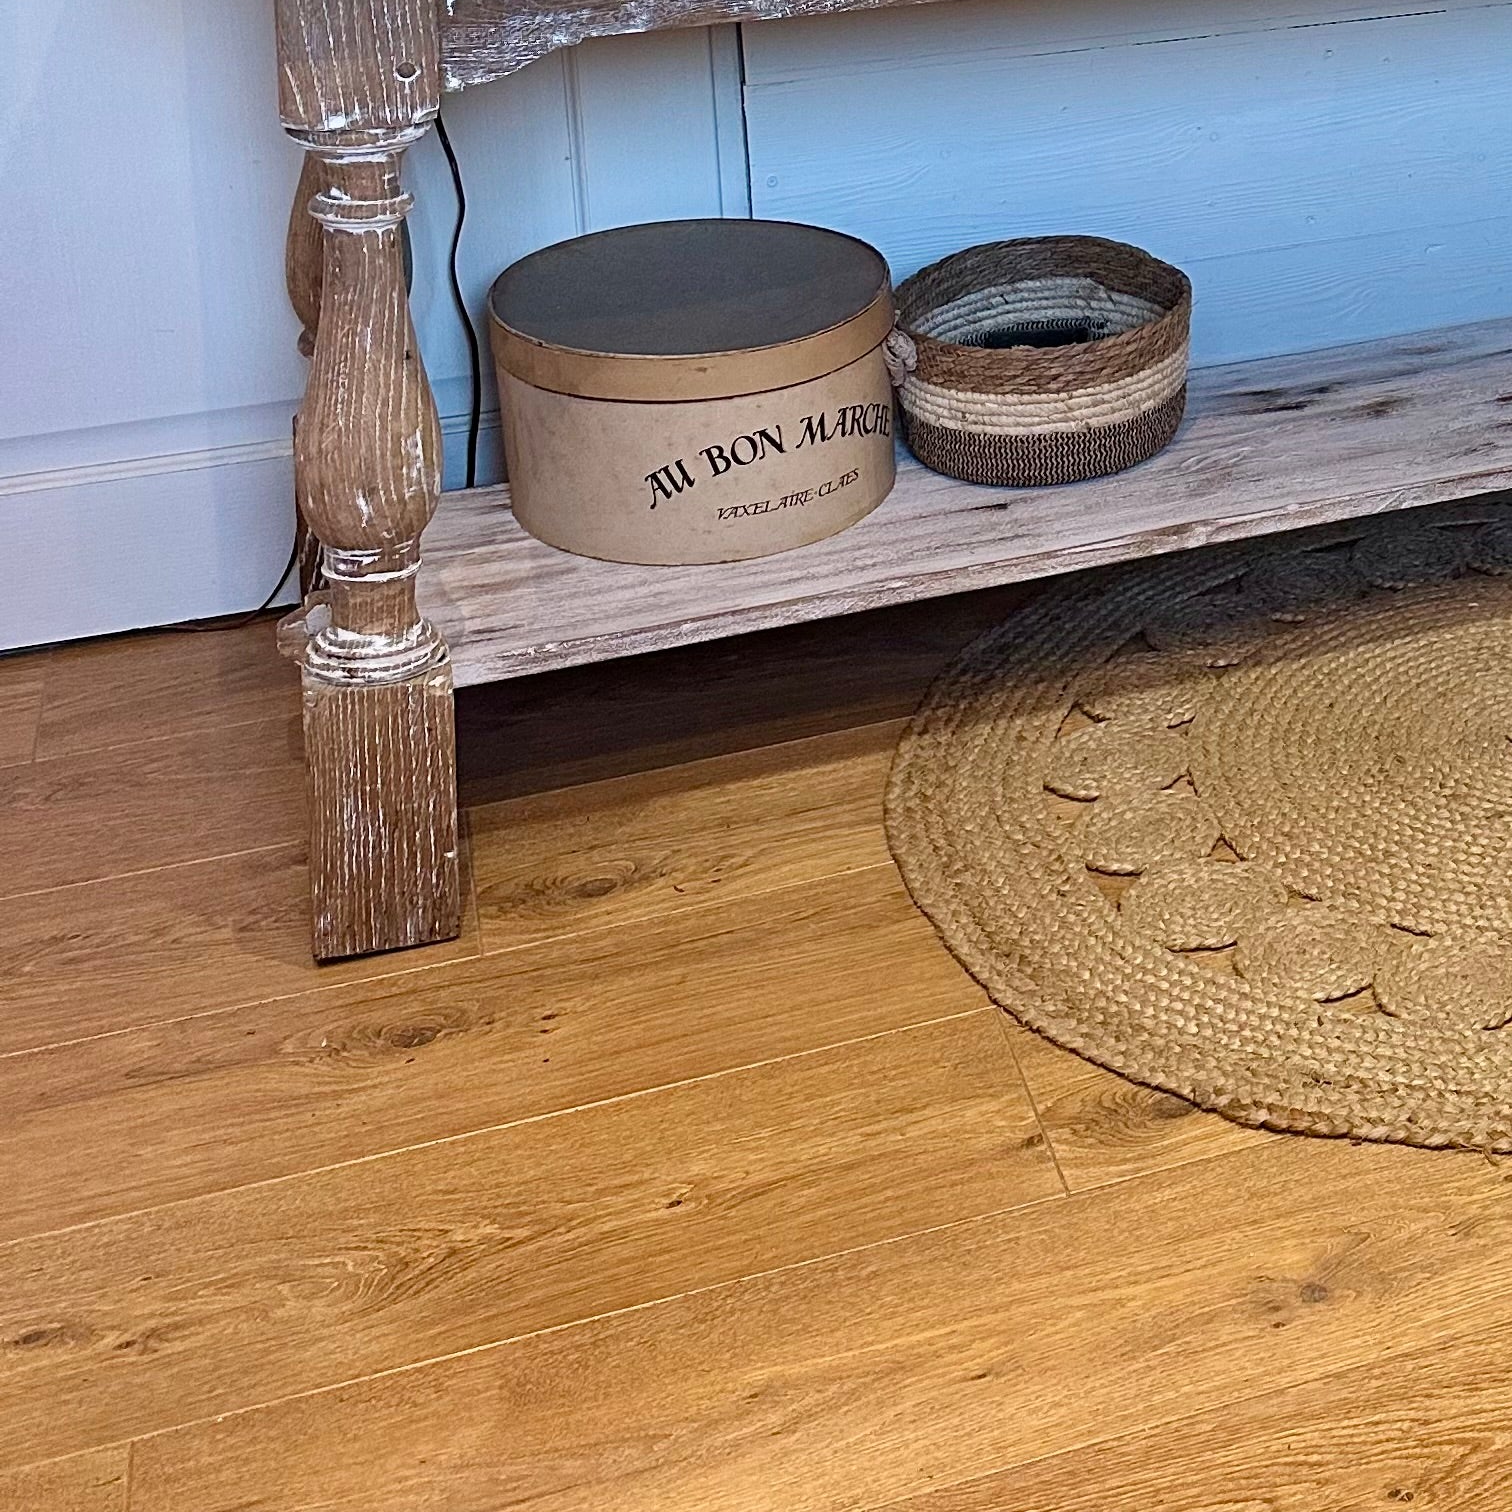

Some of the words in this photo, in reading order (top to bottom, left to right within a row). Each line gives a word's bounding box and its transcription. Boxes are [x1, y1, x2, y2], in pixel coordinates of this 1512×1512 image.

[645, 458, 696, 509] AU
[699, 425, 786, 477] BON
[796, 403, 889, 448] MARCHE
